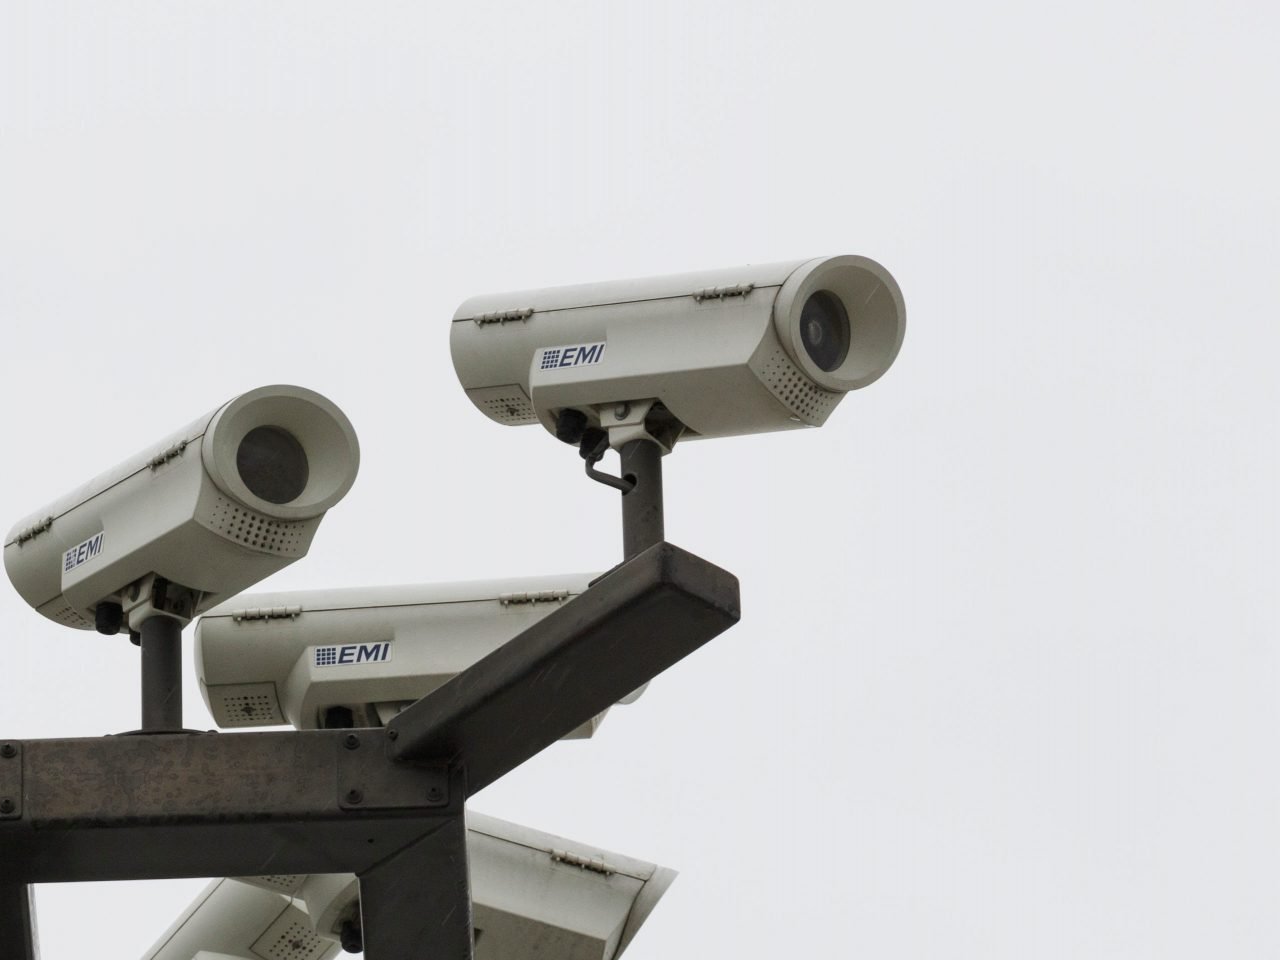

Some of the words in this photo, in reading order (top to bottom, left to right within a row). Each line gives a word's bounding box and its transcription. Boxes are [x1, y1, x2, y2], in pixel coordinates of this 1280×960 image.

[558, 344, 604, 367] EMI
[76, 533, 104, 565] EMI
[338, 643, 389, 664] EMI
